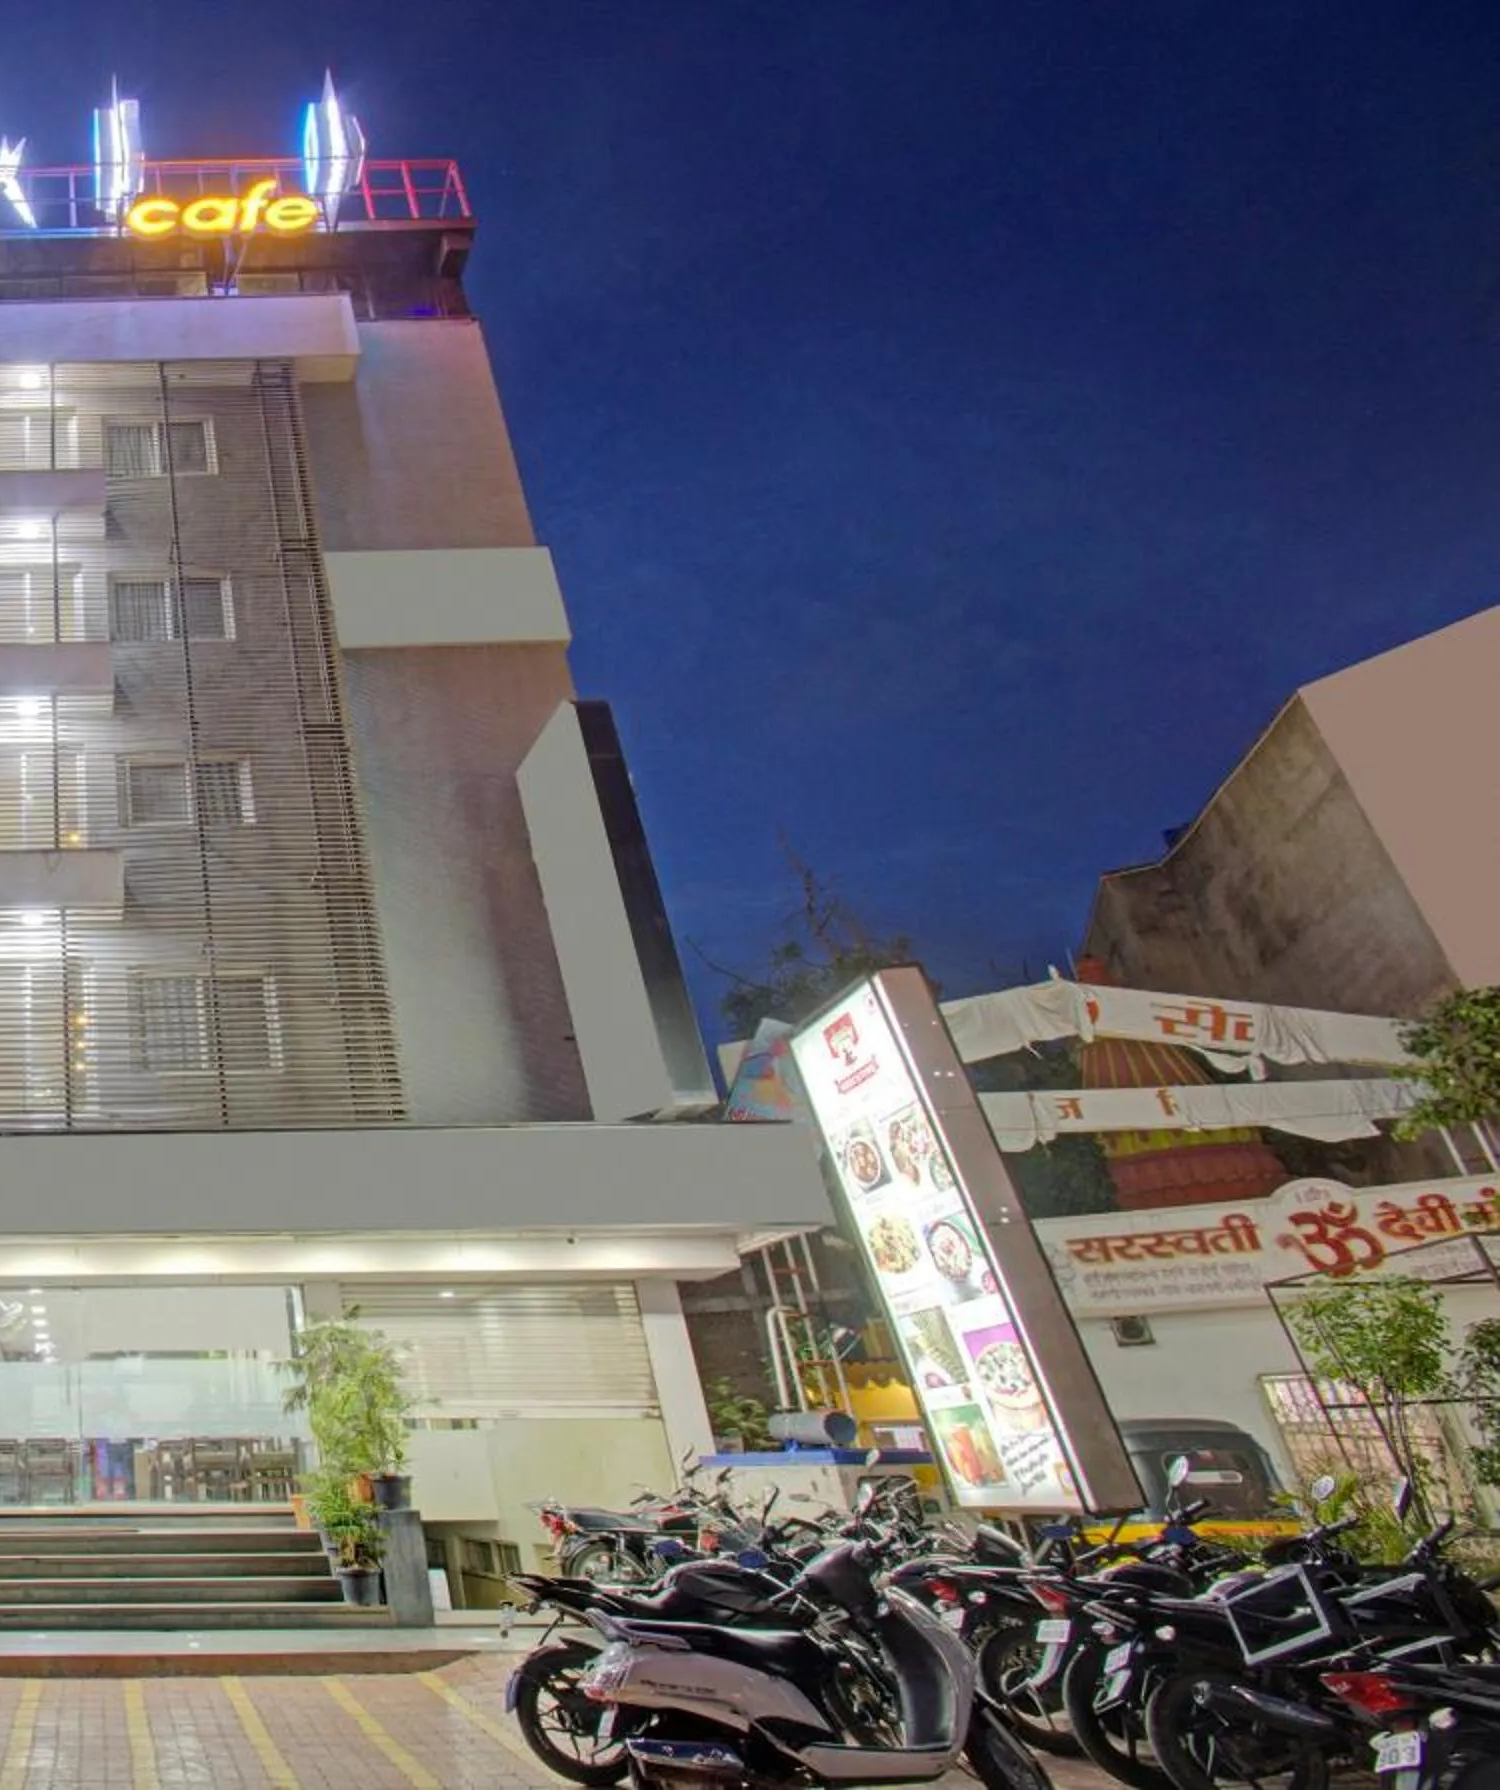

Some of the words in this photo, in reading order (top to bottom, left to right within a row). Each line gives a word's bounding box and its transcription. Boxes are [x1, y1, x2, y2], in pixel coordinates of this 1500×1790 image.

[128, 179, 320, 236] cafe
[1066, 1213, 1263, 1264] सरस्वती
[1373, 1193, 1462, 1240] देवी
